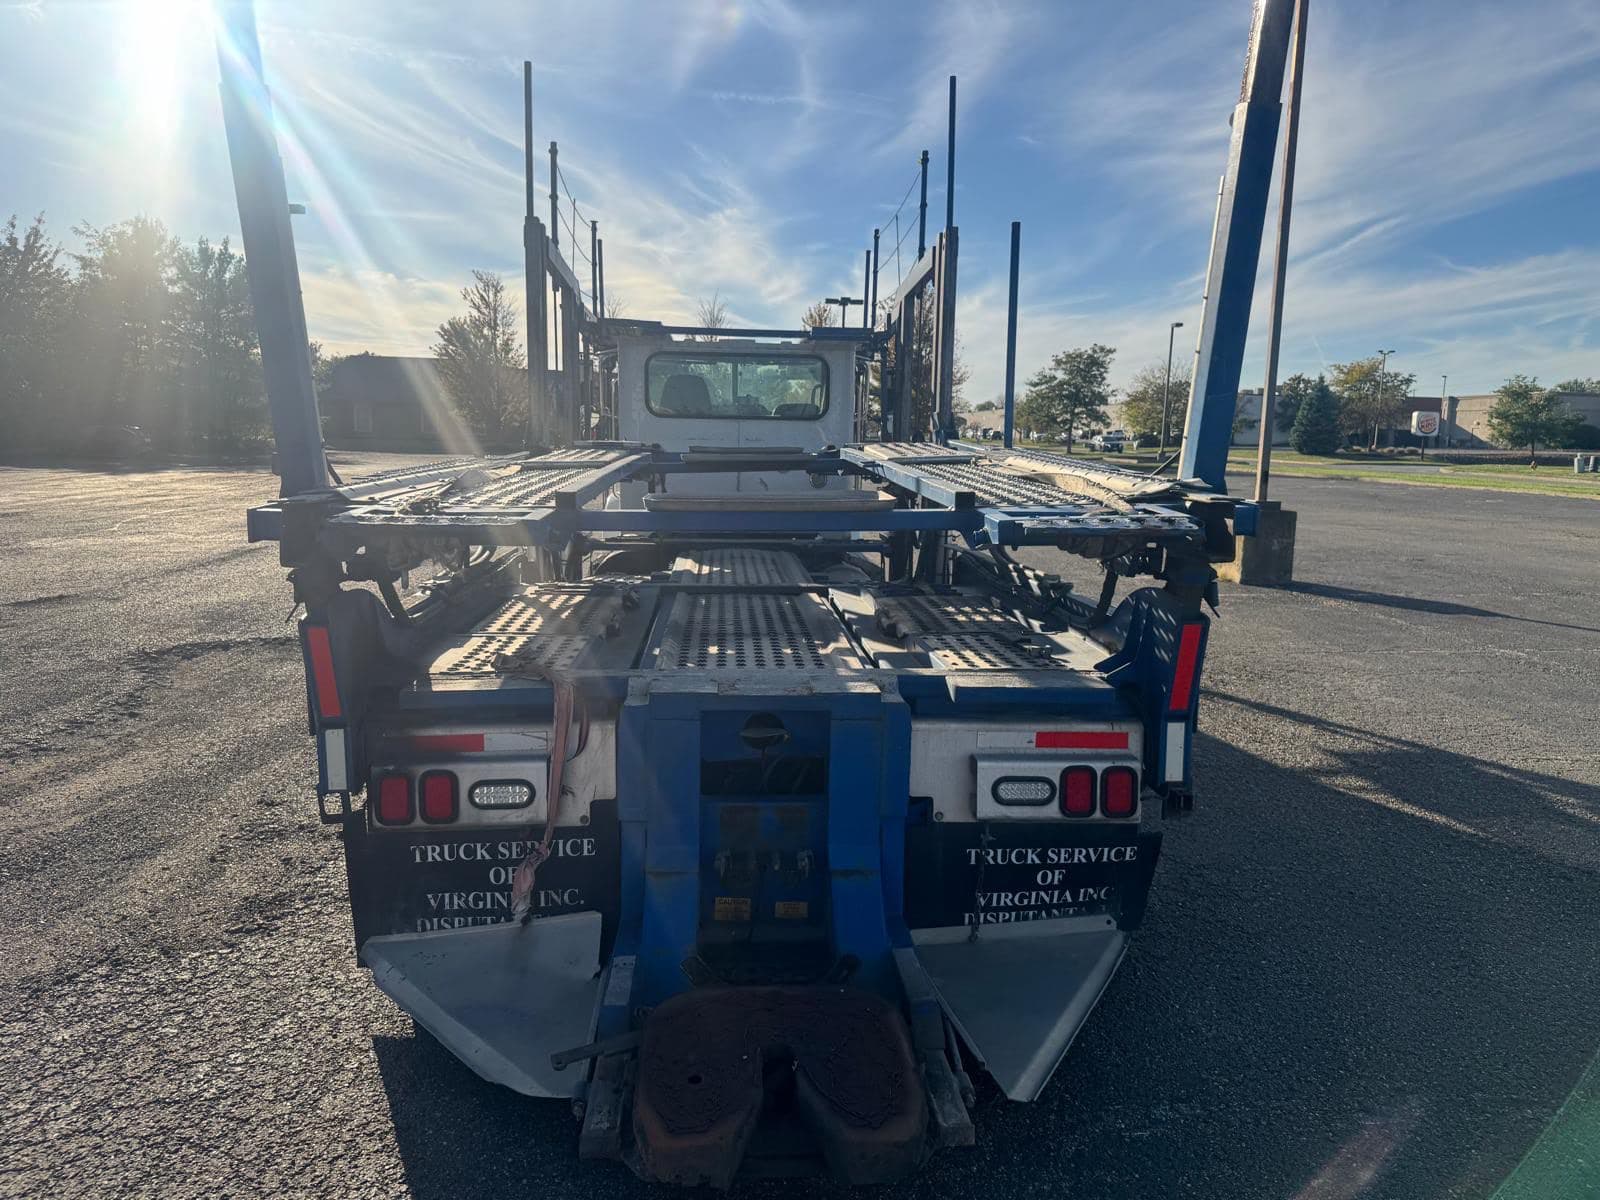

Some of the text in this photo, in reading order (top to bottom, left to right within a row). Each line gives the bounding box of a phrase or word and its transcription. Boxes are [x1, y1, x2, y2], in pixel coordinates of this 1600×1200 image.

[410, 843, 492, 863] TRUCK
[967, 847, 1137, 864] TRUCK SERVICE
[1037, 869, 1066, 886] OF
[427, 888, 585, 909] VIRGIN INC.
[978, 890, 1073, 907] VIRGINIA
[964, 907, 1084, 926] DISPUTAN
